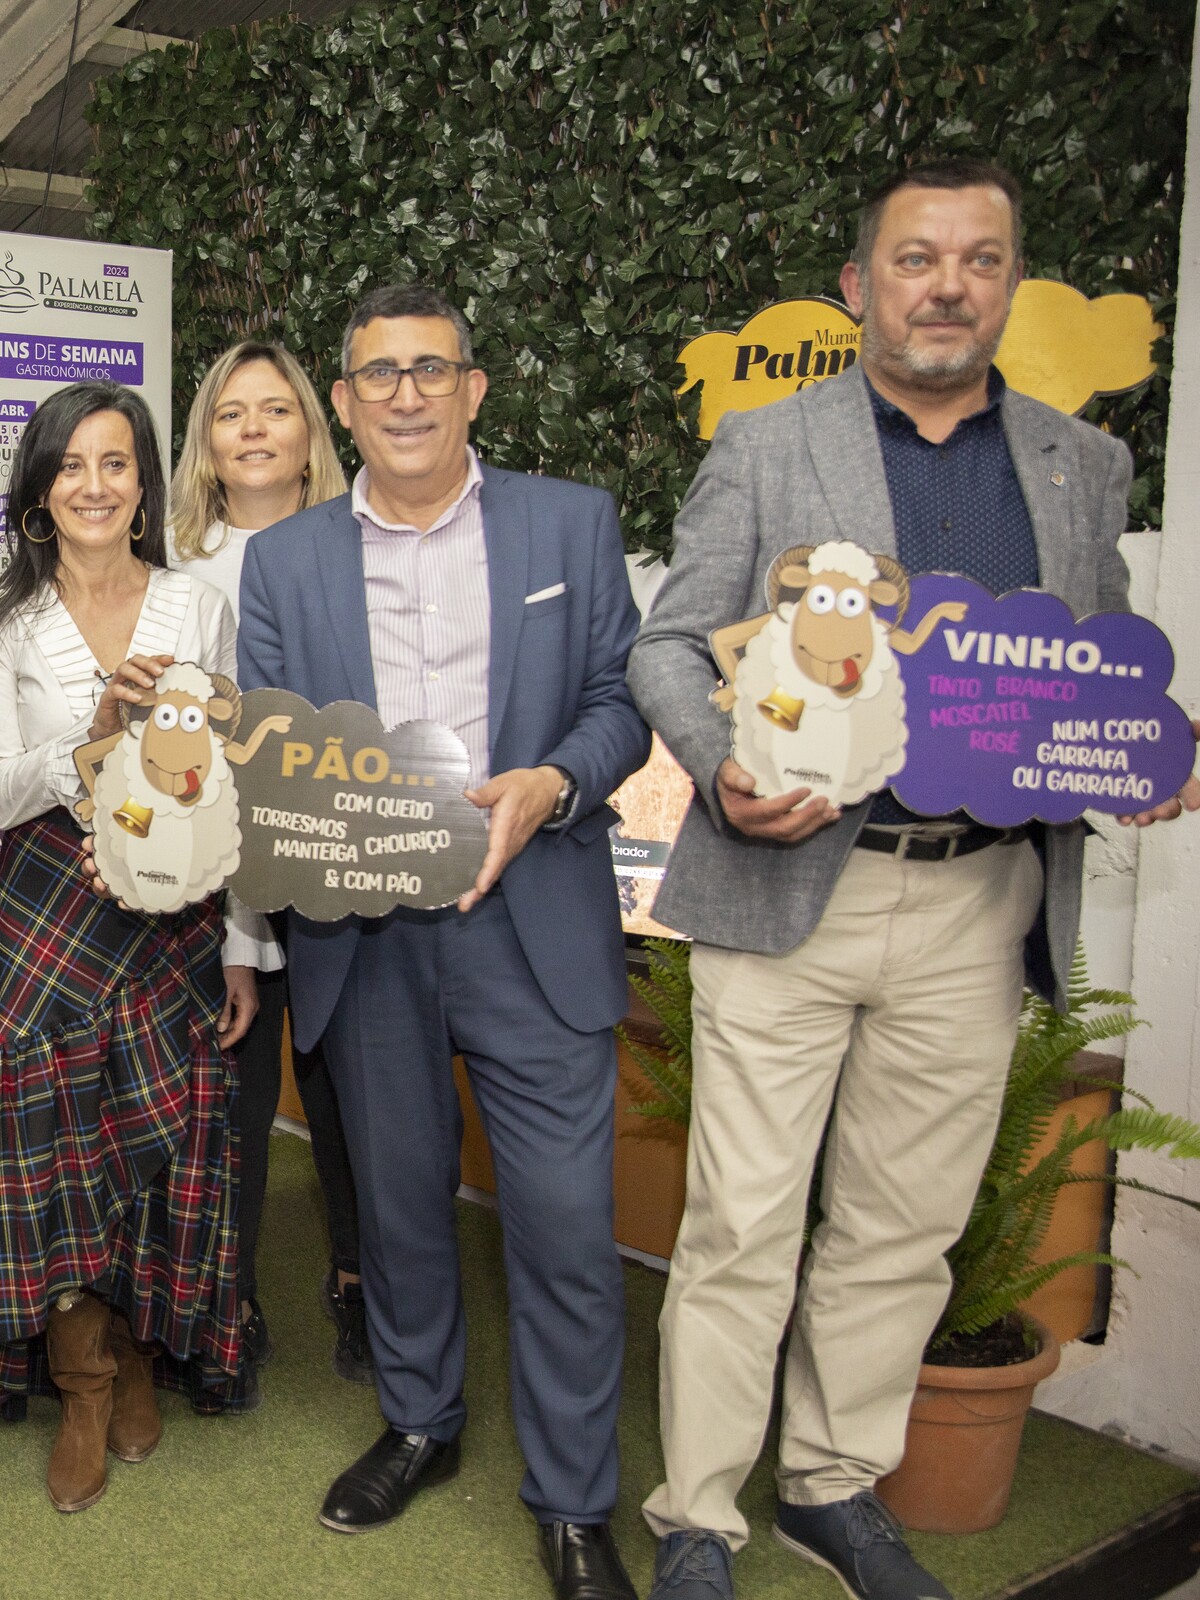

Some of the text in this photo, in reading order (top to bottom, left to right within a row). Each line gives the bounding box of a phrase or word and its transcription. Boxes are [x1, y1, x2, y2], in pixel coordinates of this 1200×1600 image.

[106, 266, 127, 277] 2024
[38, 271, 144, 303] PALMELA
[35, 343, 56, 361] DE
[61, 345, 138, 366] SEMANA
[16, 363, 111, 380] GASTRONÓMICOS
[0, 404, 29, 417] ABR.
[943, 629, 1143, 678] VINHO...
[996, 676, 1078, 702] BRANCO
[929, 700, 1031, 728] MOSCATEL
[969, 729, 1021, 754] ROSÉ
[1052, 718, 1161, 742] NUM COPO
[281, 736, 436, 788] PÃO...
[1036, 742, 1128, 772] GARRAFA
[1012, 765, 1153, 801] OU GARRAFÃO
[333, 792, 373, 814] COM
[251, 806, 348, 840] TORRESMOS
[324, 868, 422, 895] & COM PÃO
